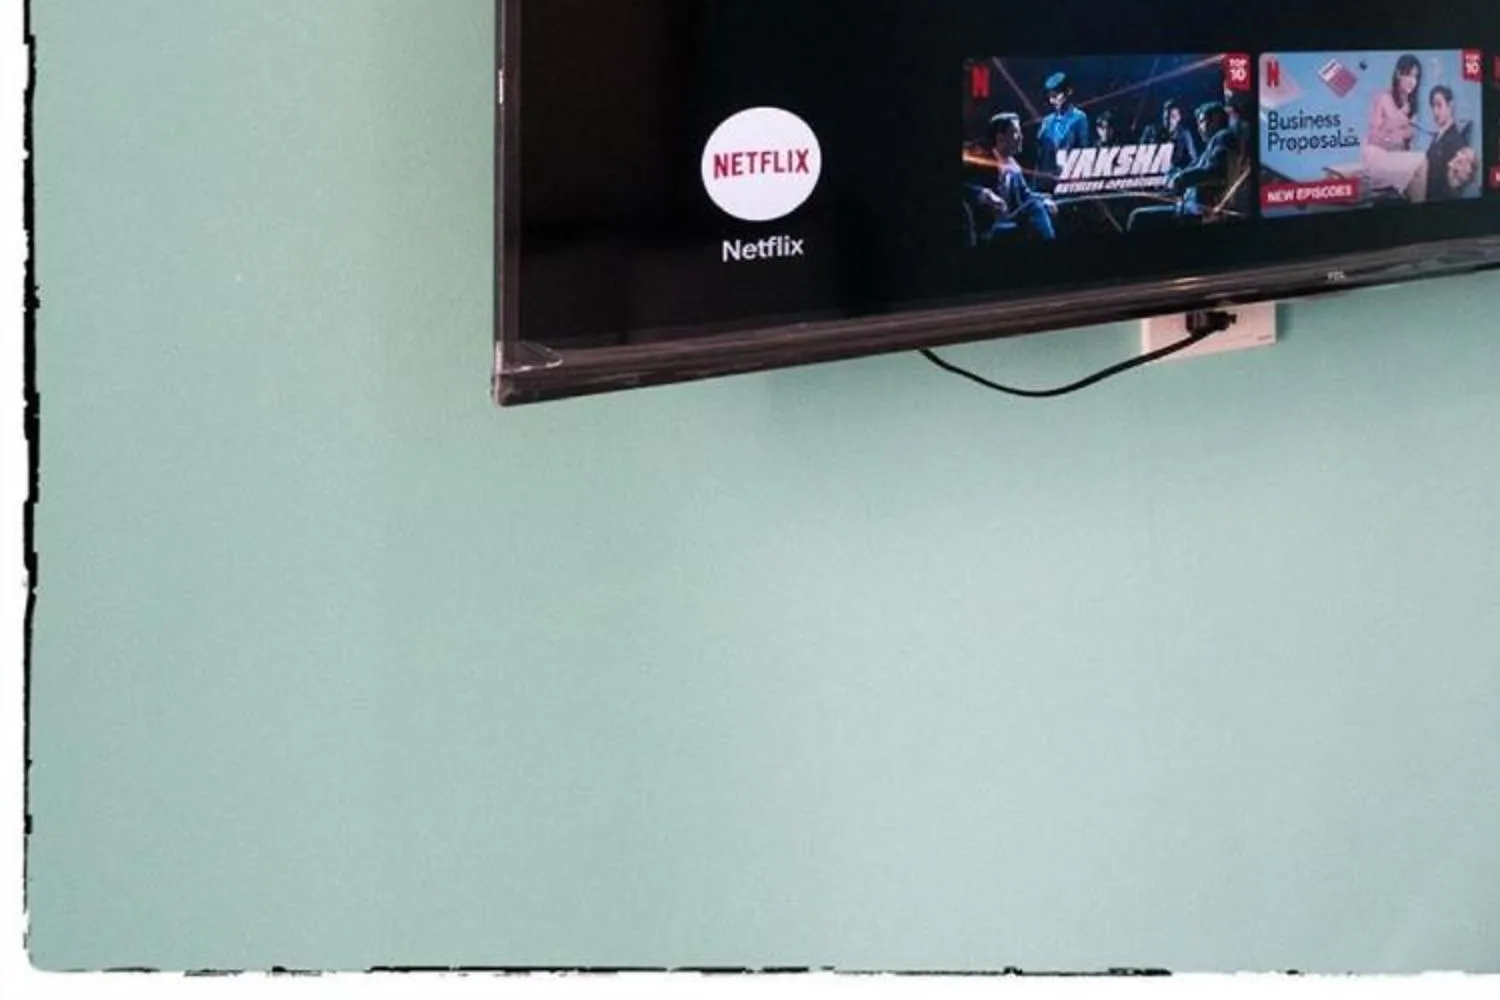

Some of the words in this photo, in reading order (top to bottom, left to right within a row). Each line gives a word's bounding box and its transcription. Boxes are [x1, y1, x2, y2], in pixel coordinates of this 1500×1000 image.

[1230, 67, 1247, 82] 10
[1267, 110, 1341, 131] Business
[713, 148, 810, 179] NETFLIX
[1056, 143, 1175, 181] YAKSHA
[1267, 189, 1295, 203] NEW
[1296, 184, 1353, 200] EPISODES
[721, 235, 804, 262] Netflix
